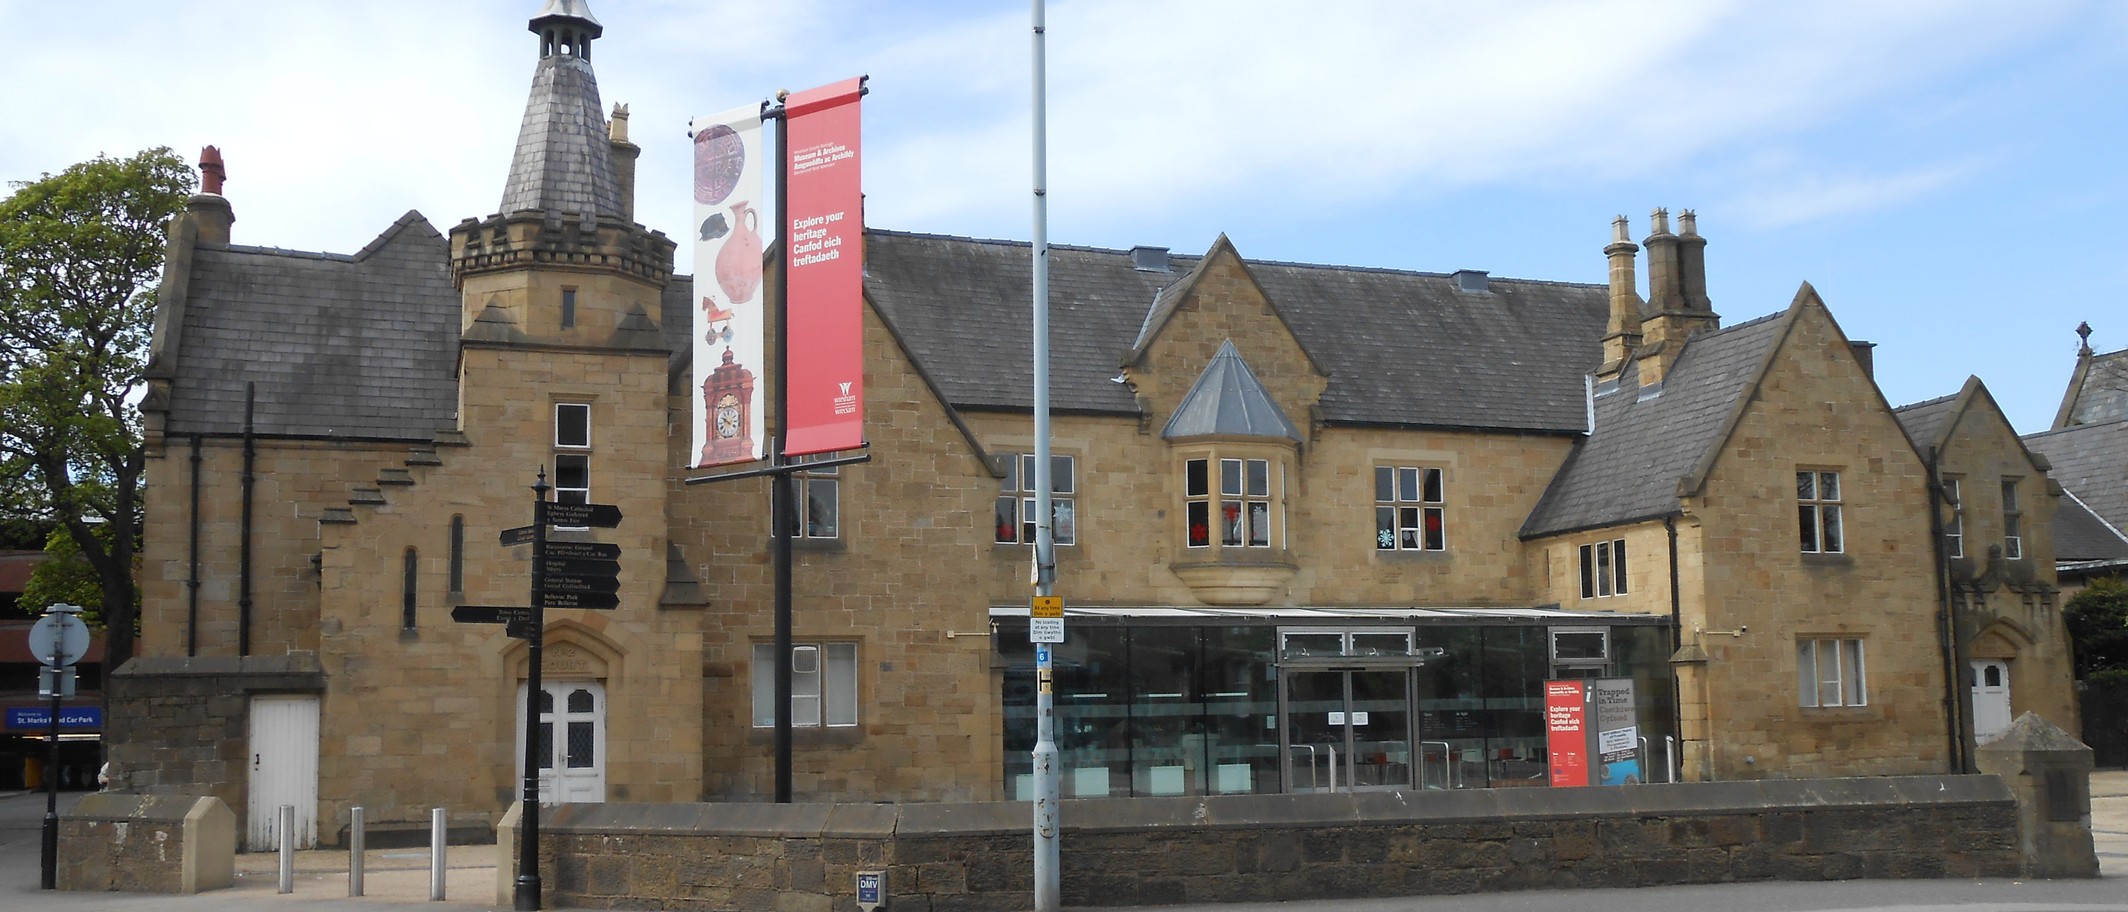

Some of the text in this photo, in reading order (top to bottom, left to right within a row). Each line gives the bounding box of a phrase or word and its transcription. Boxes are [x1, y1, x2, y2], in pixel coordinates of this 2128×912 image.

[794, 152, 816, 162] Museum
[823, 145, 846, 155] Archives
[794, 211, 844, 230] Explore your
[794, 228, 827, 242] heritage
[793, 236, 841, 254] Canfod eich
[793, 249, 839, 267] treftadaeth
[1598, 688, 1630, 697] Trapped
[860, 880, 877, 888] DMV
